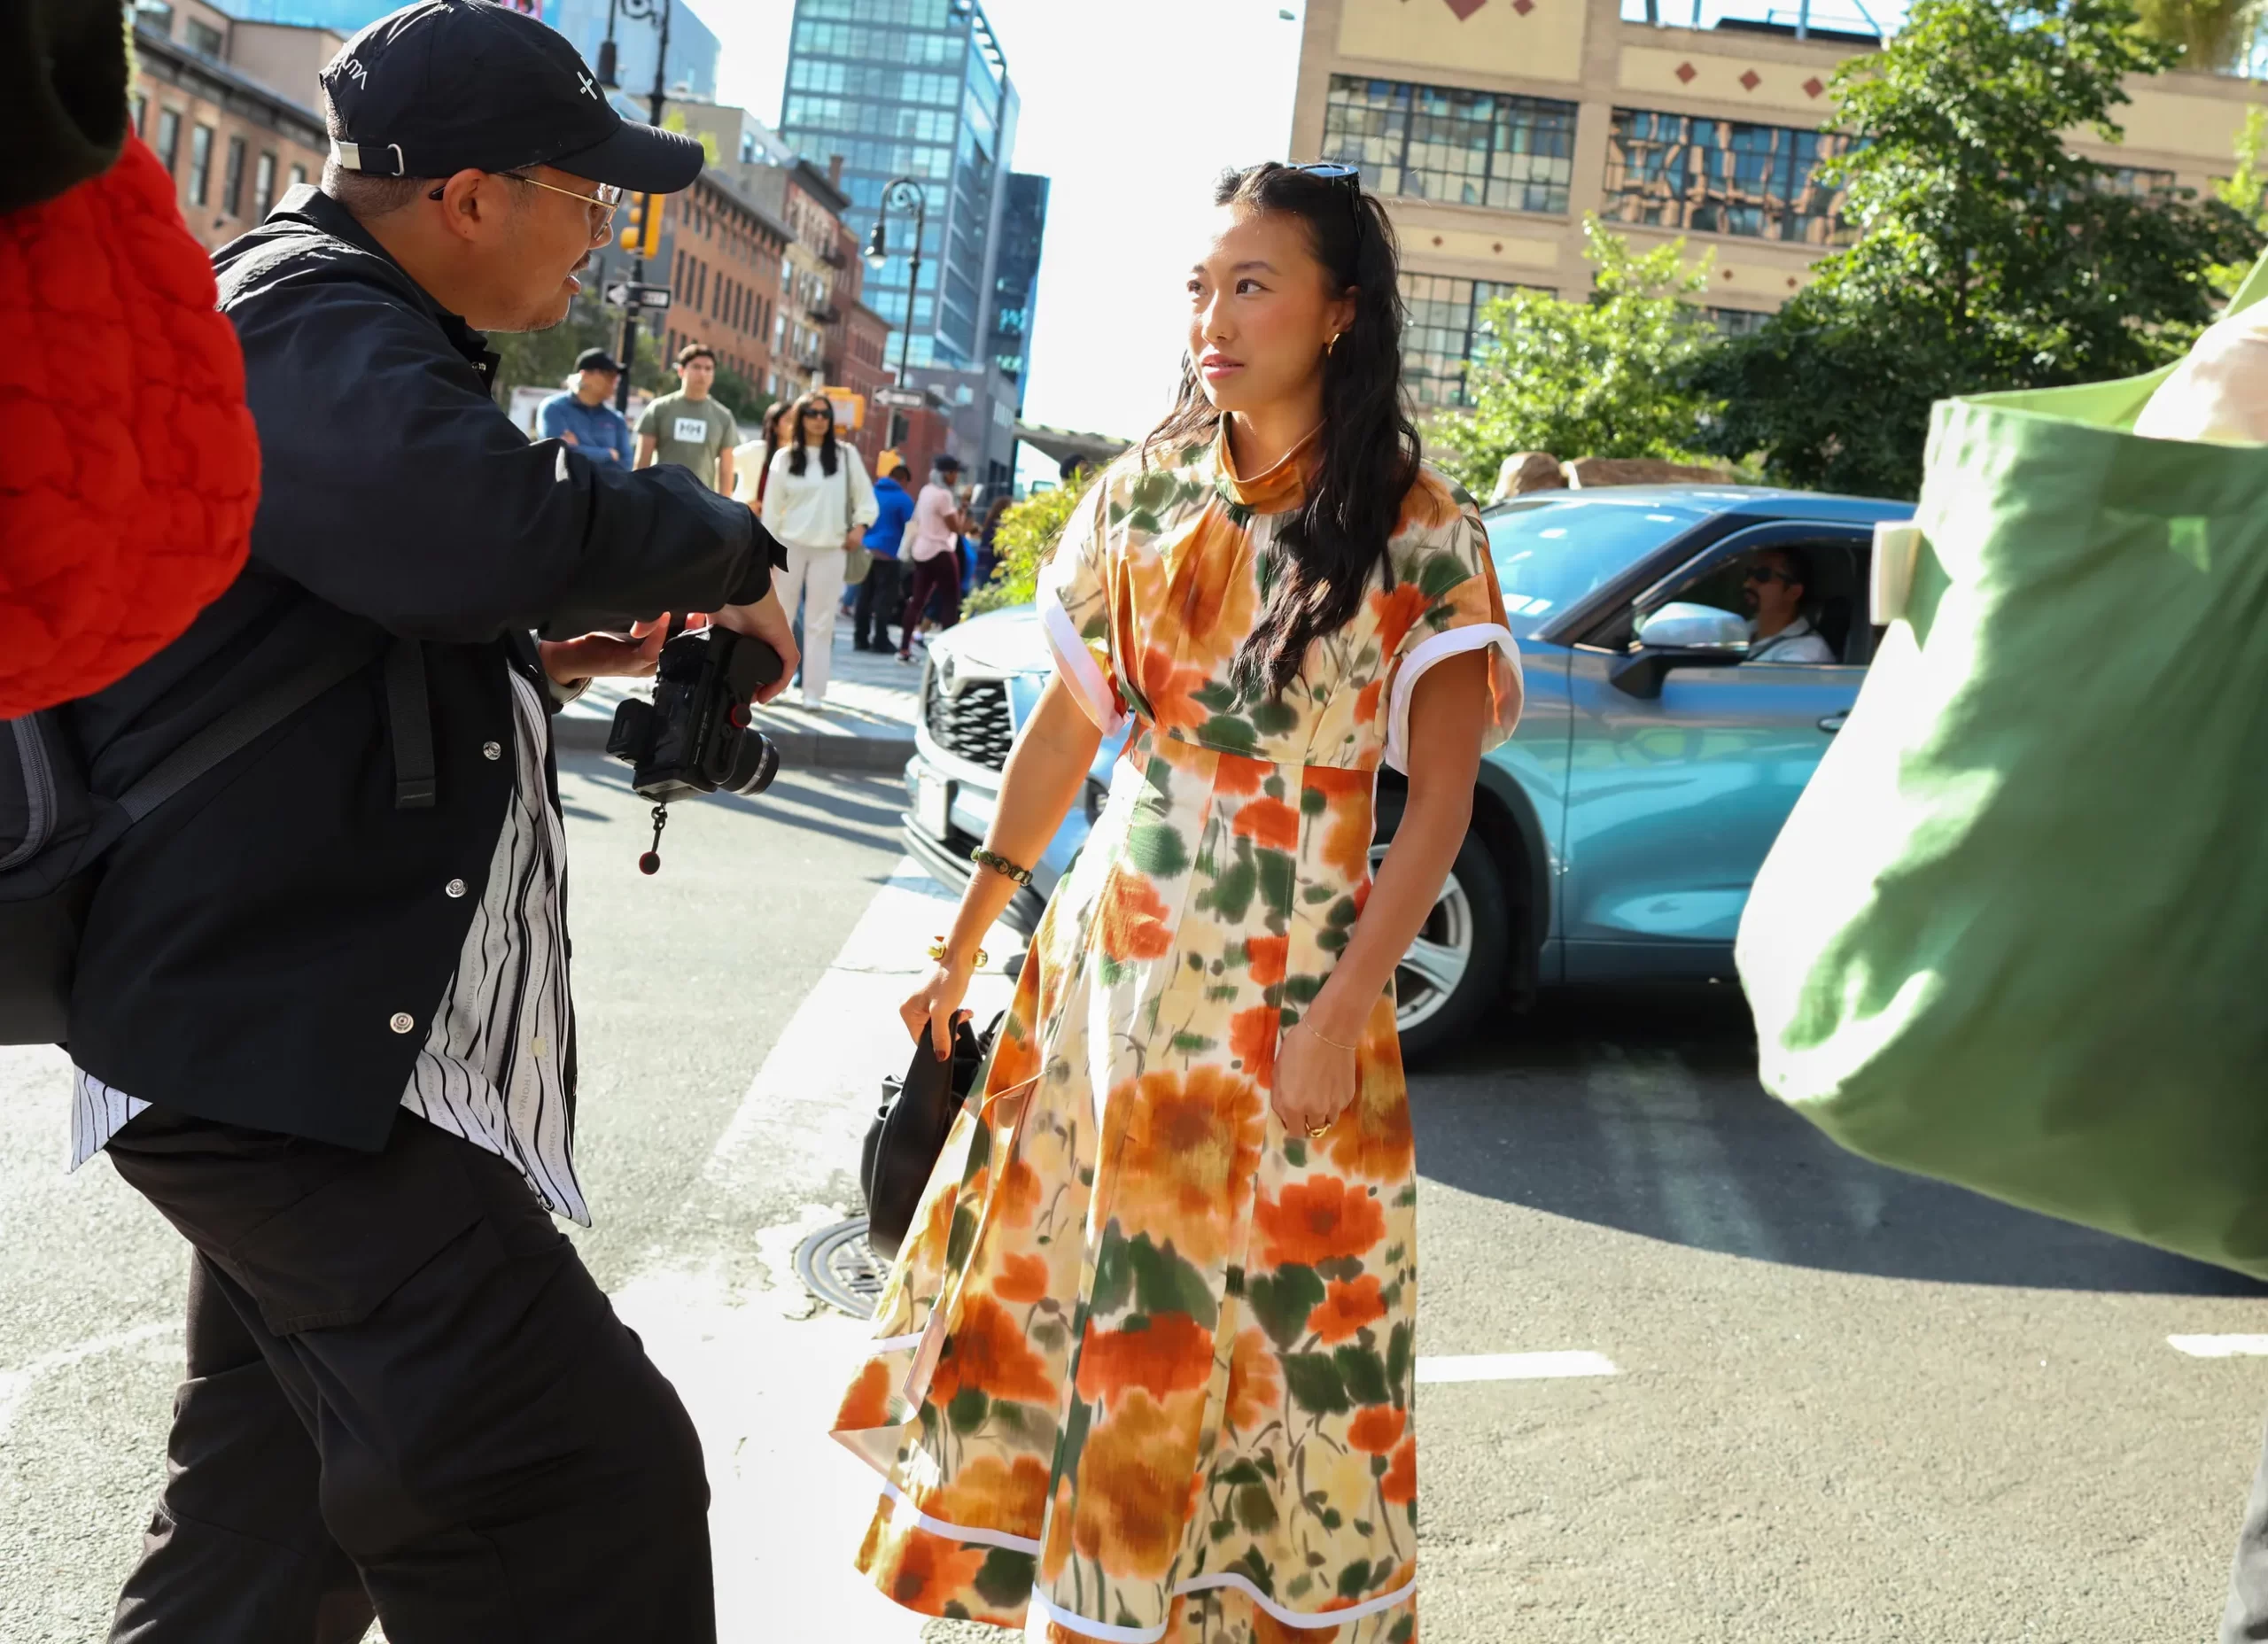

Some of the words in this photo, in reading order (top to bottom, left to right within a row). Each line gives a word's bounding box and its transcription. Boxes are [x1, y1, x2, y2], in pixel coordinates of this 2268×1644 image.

[470, 916, 481, 982] PETRONAS
[517, 1057, 532, 1119] PETRONAS
[548, 1123, 562, 1177] FORMULA
